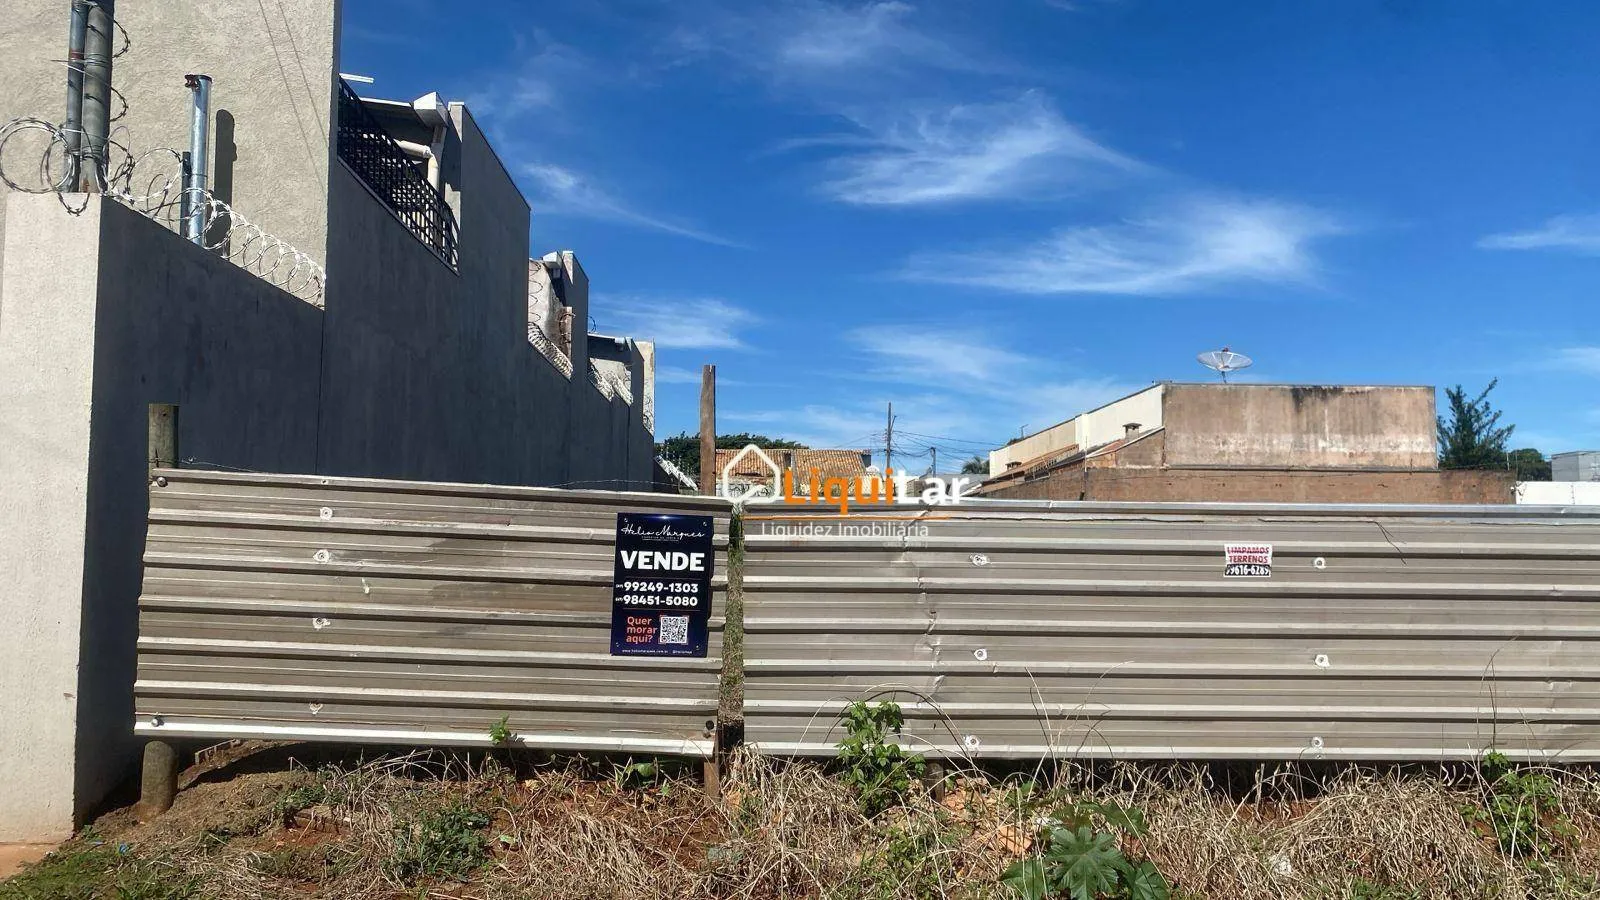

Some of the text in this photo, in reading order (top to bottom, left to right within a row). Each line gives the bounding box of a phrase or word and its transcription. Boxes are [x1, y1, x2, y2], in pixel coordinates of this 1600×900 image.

[1227, 546, 1270, 555] LIMPAMOS
[620, 550, 705, 572] VENDE
[1228, 555, 1269, 564] TERRENOS
[627, 616, 652, 626] Quer
[626, 626, 658, 635] morar
[626, 635, 653, 645] aqui?
